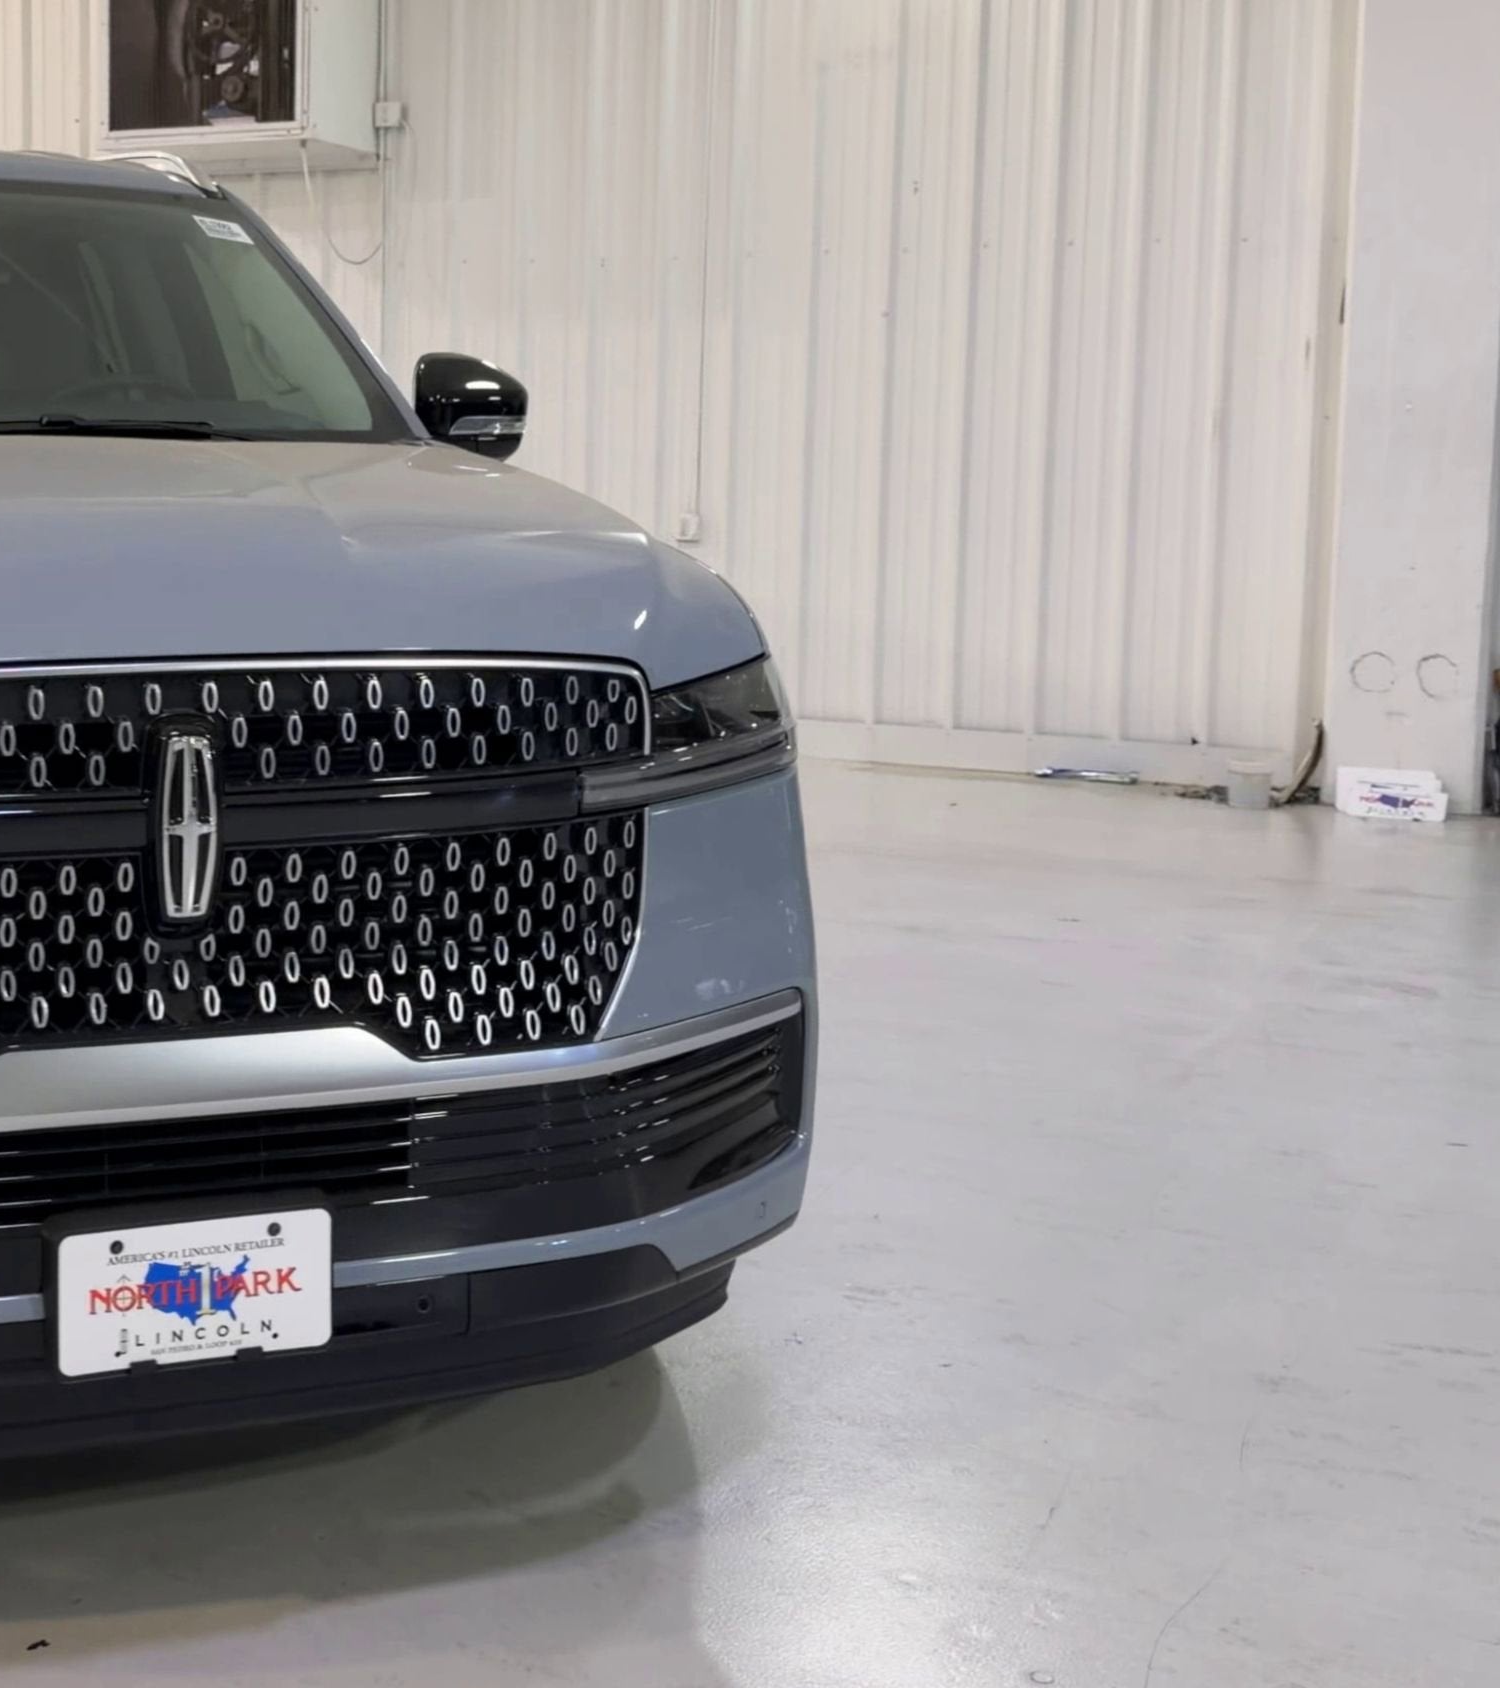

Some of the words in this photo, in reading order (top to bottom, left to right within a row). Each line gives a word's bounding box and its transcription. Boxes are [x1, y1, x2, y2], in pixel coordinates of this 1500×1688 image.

[107, 1251, 165, 1266] AMERICA'S
[182, 1243, 232, 1258] LINCOLN
[234, 1237, 285, 1252] RETAILER
[89, 1279, 197, 1315] NORTH
[216, 1267, 302, 1300] PARK
[134, 1319, 273, 1347] LINCOLN
